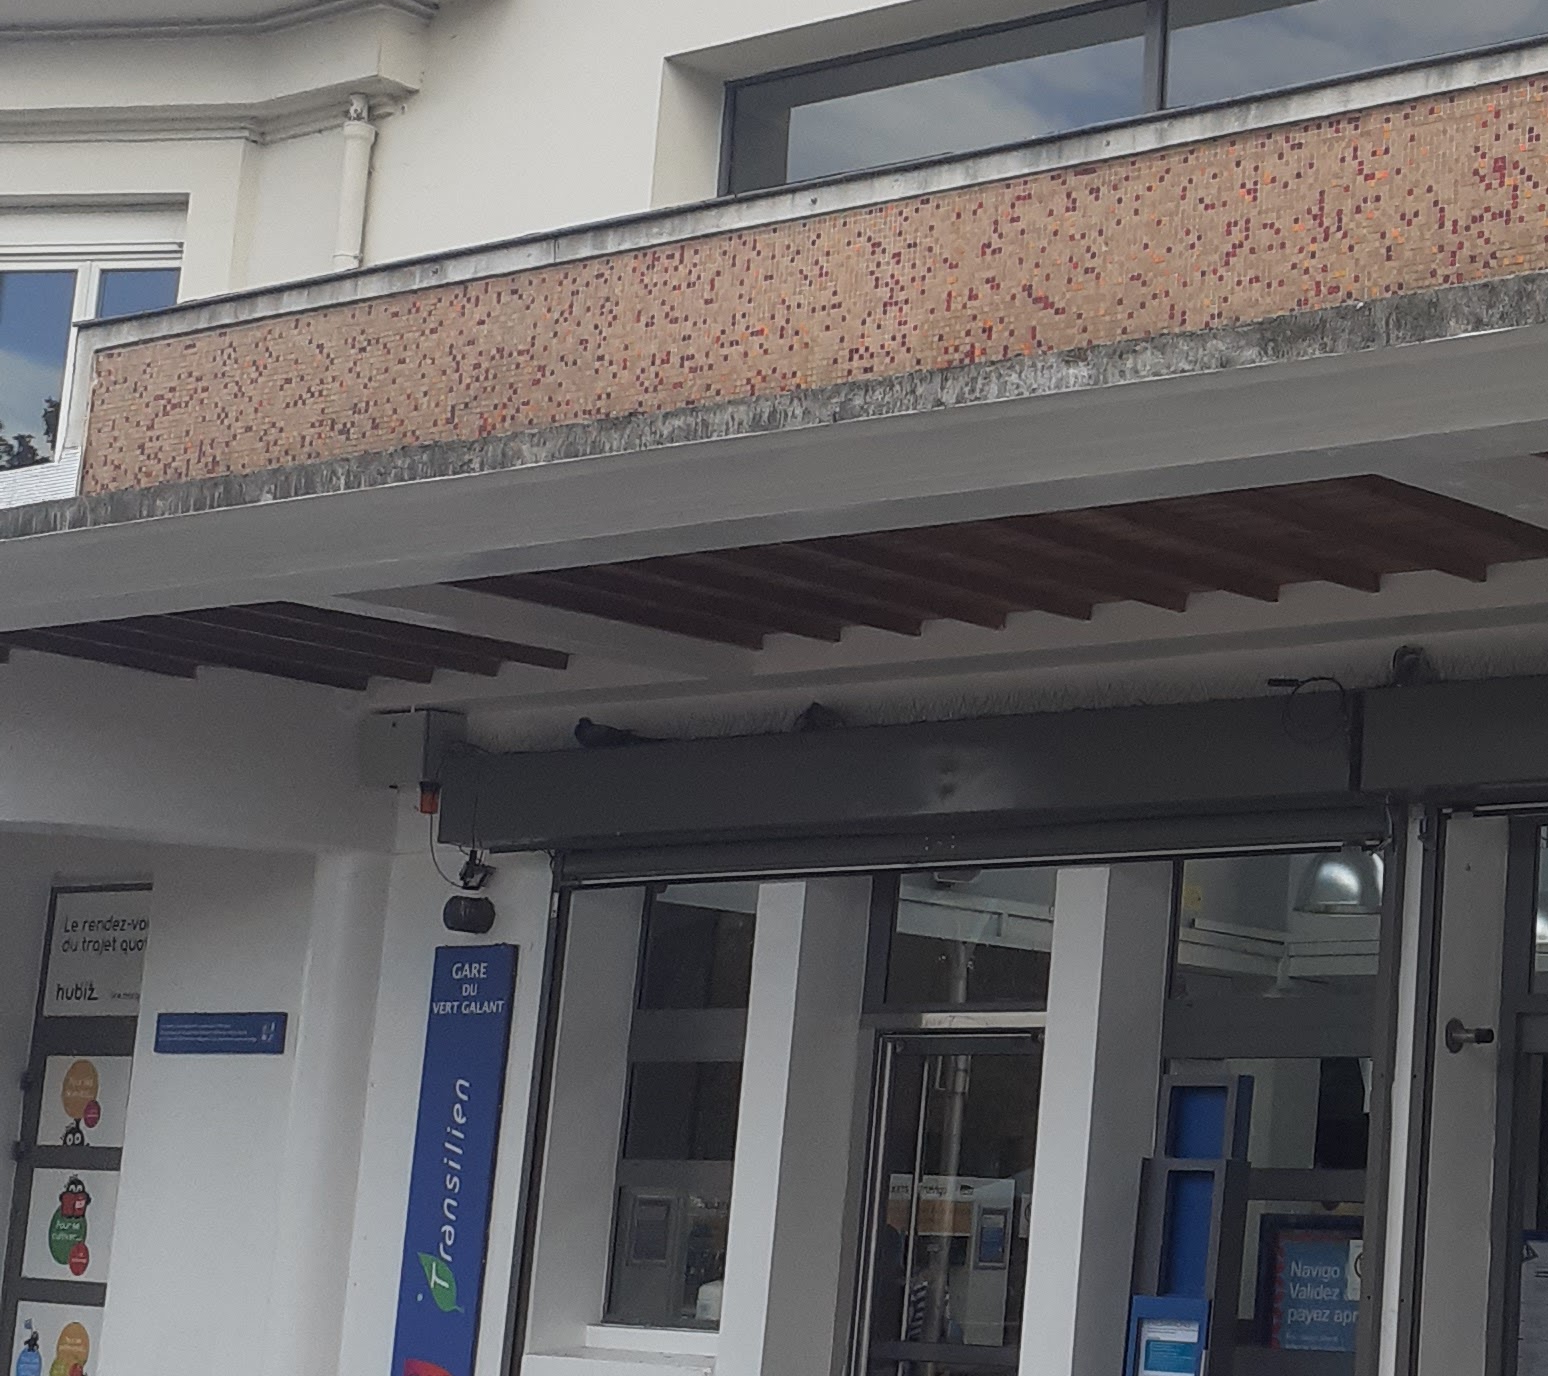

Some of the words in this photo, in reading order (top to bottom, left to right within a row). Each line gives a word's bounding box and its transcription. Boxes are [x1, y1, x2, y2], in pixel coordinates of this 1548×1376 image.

[64, 916, 79, 933] Le
[81, 915, 149, 933] rendez-vo
[452, 962, 488, 979] GARE
[462, 983, 478, 997] DU
[432, 1001, 460, 1015] VERT
[461, 1000, 505, 1014] GALANT
[430, 1078, 471, 1289] Transilien
[1290, 1261, 1340, 1282] Navigo
[1289, 1283, 1339, 1300] Validez
[1287, 1308, 1330, 1325] payez
